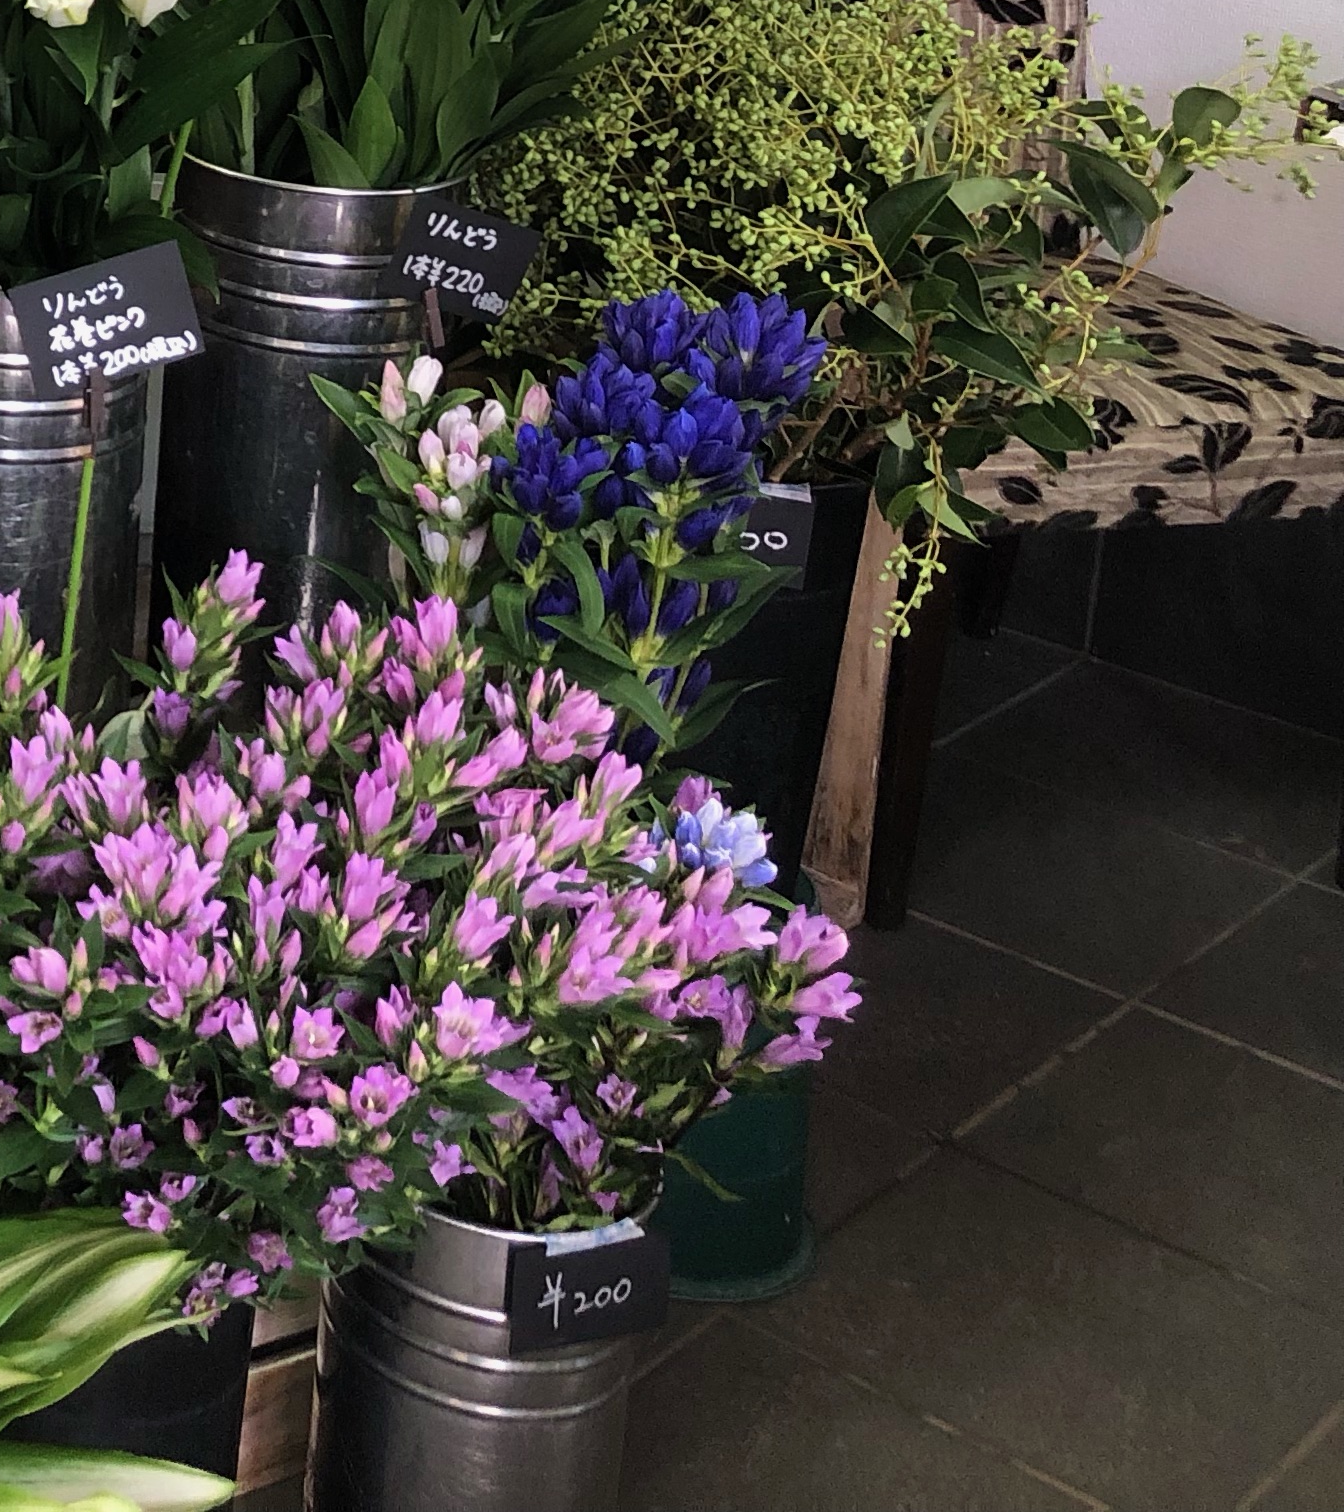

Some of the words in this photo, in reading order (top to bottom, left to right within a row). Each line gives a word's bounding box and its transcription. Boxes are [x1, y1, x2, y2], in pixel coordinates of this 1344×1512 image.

[427, 211, 498, 251] りんどう
[42, 274, 125, 320] りんどう
[537, 1271, 632, 1330] ¥200
